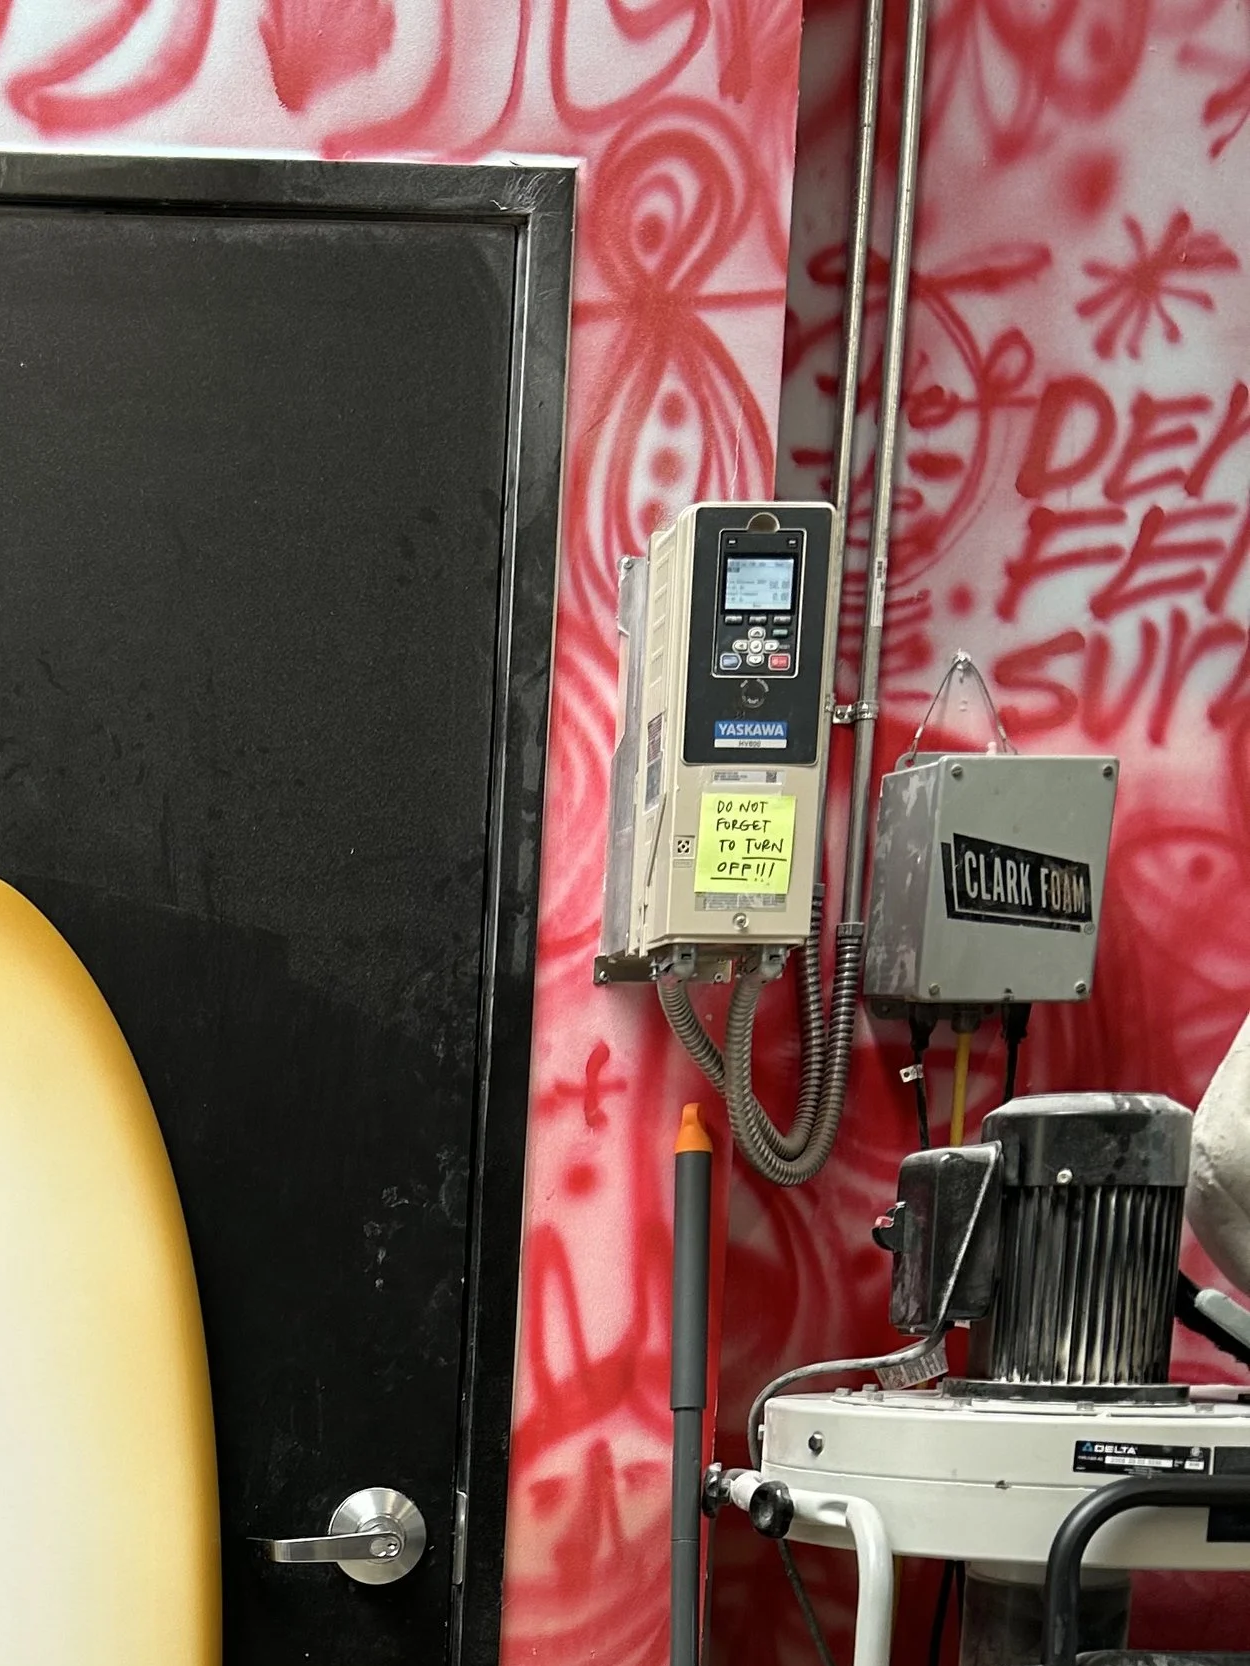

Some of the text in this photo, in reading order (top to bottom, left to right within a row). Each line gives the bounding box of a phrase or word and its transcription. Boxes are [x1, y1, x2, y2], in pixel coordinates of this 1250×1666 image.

[717, 722, 785, 738] YASKAWA
[717, 800, 768, 814] DO NOT
[716, 817, 771, 834] FORGET
[719, 838, 784, 854] TO TURN
[963, 850, 1086, 914] CLARK FOAM
[1093, 1443, 1137, 1455] DELTA
